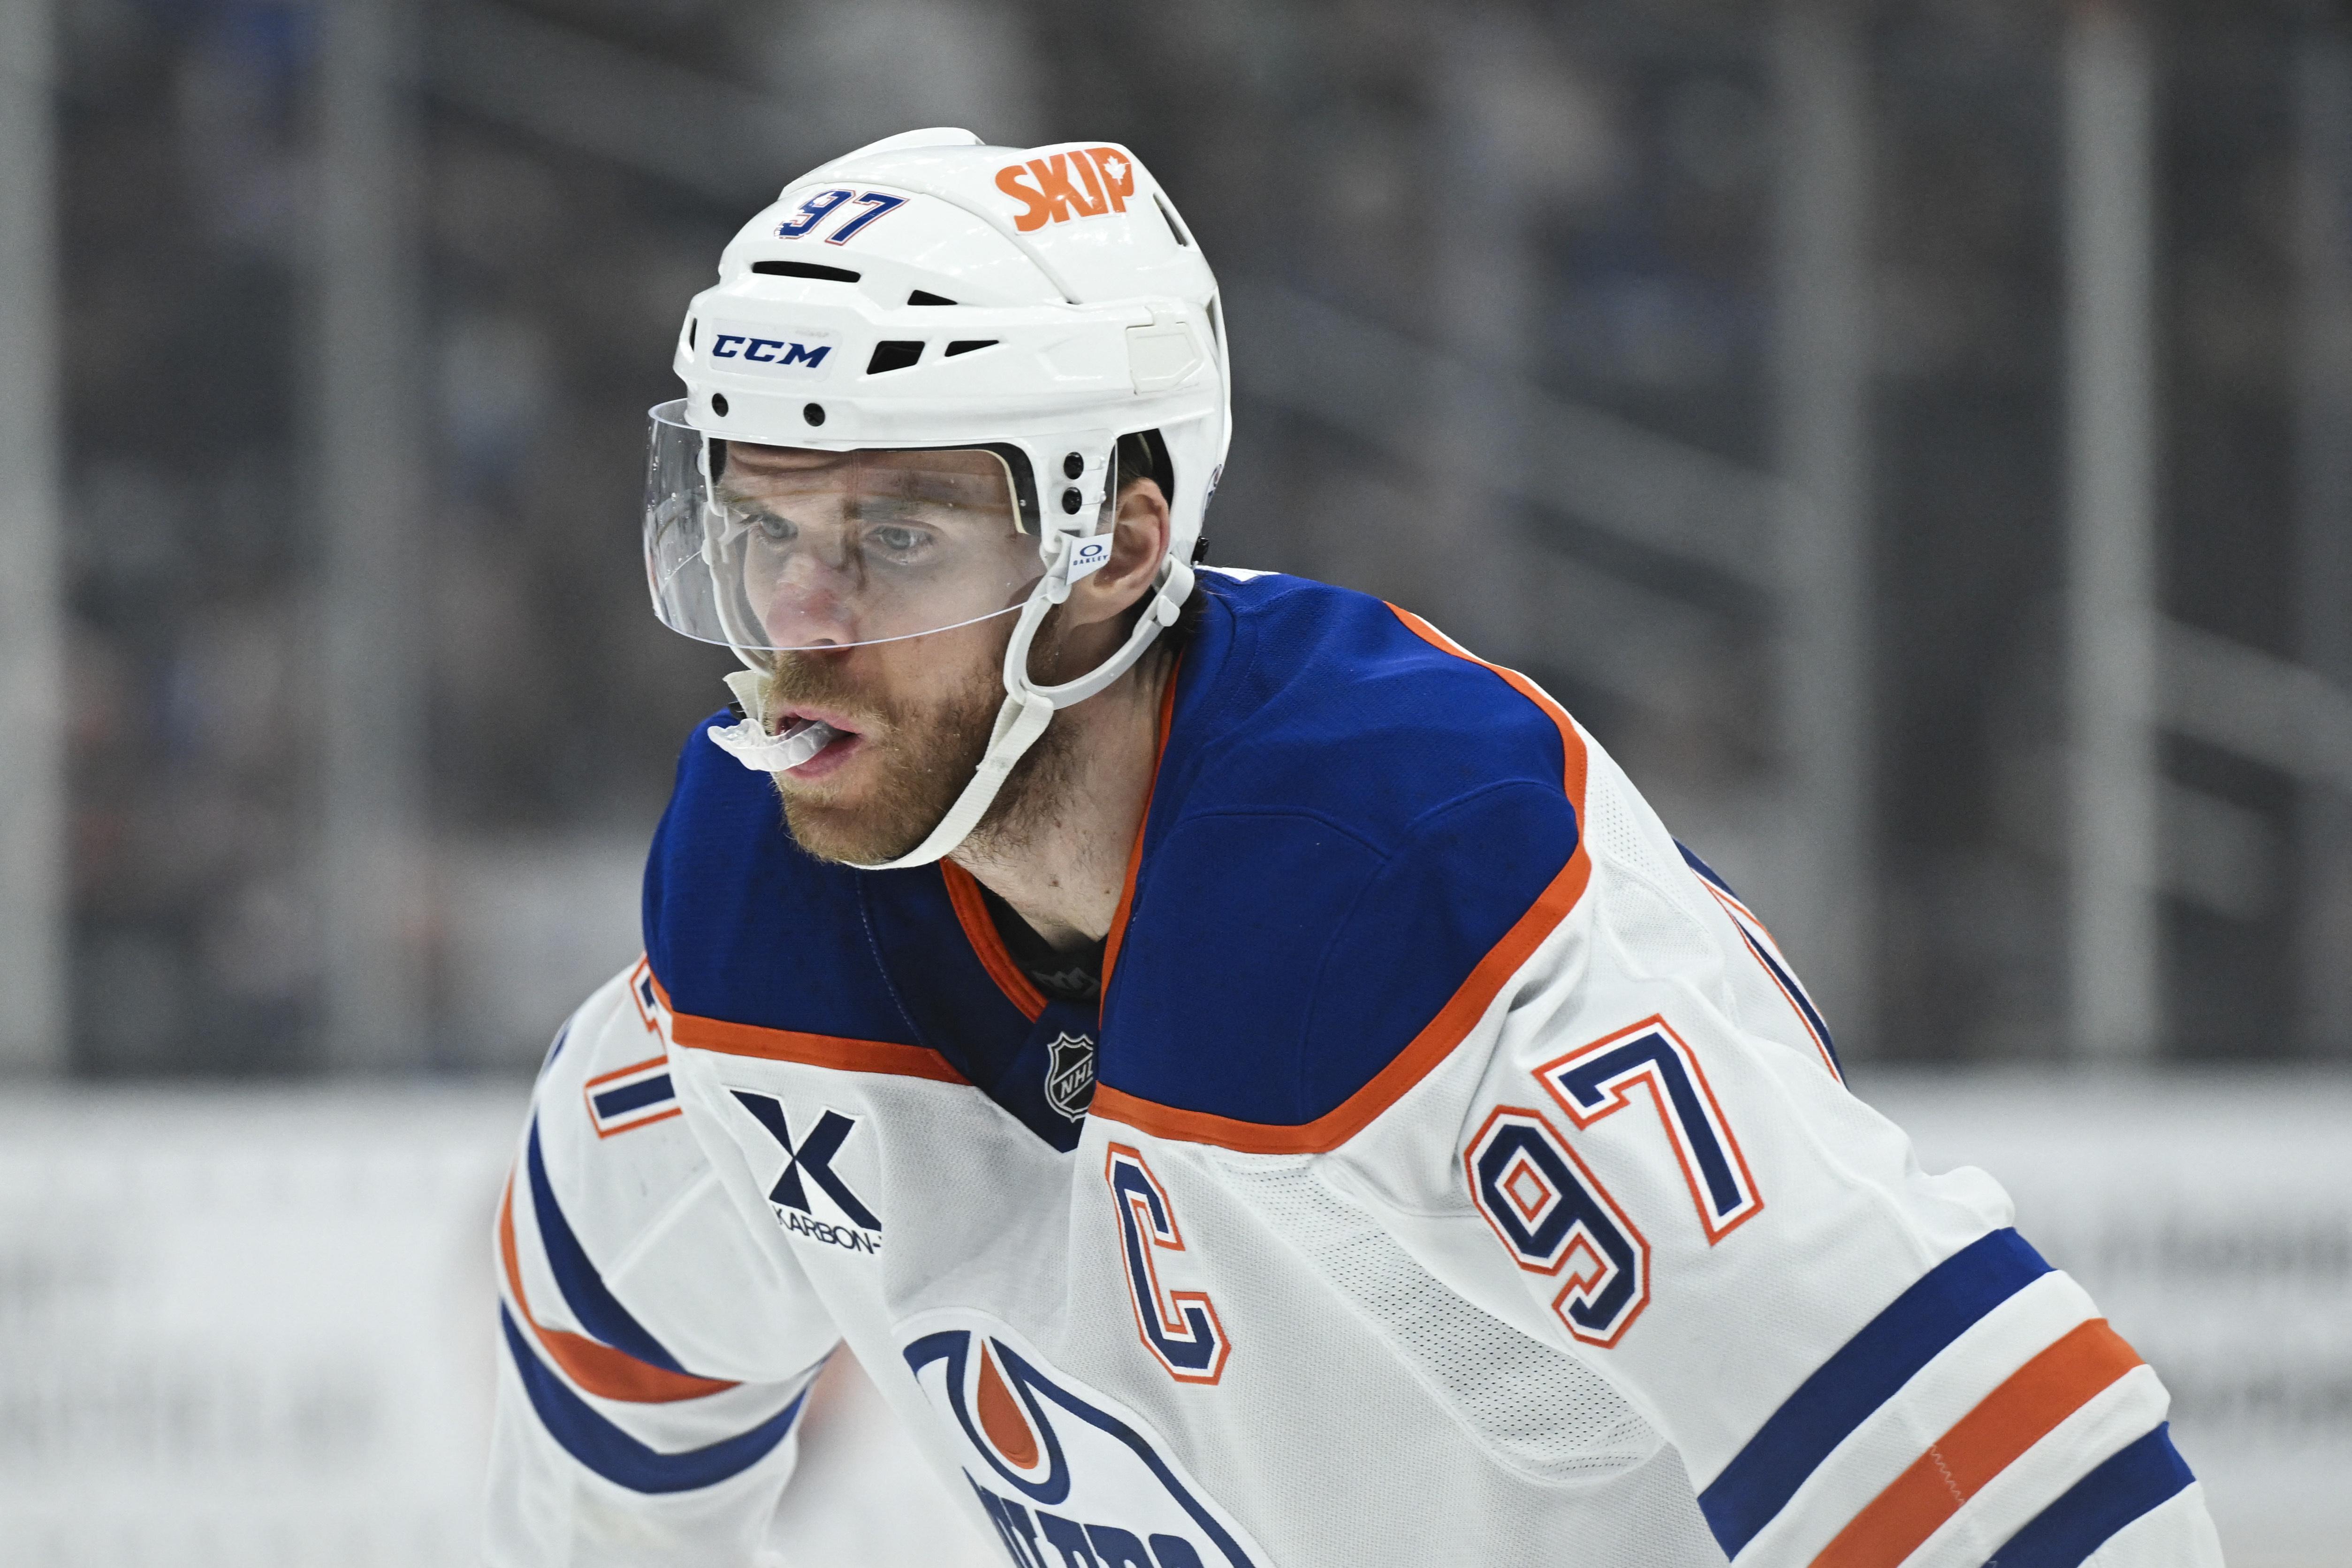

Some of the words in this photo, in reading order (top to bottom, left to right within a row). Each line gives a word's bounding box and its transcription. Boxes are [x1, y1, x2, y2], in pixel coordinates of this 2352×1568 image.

[995, 147, 1134, 232] SKIP
[774, 189, 910, 246] 97
[712, 335, 832, 368] CCM
[1073, 555, 1109, 565] OAKLEY
[1060, 1058, 1094, 1099] NHL
[1463, 1013, 1765, 1350] 97
[772, 1205, 882, 1254] KARBON-
[1105, 1142, 1232, 1385] C
